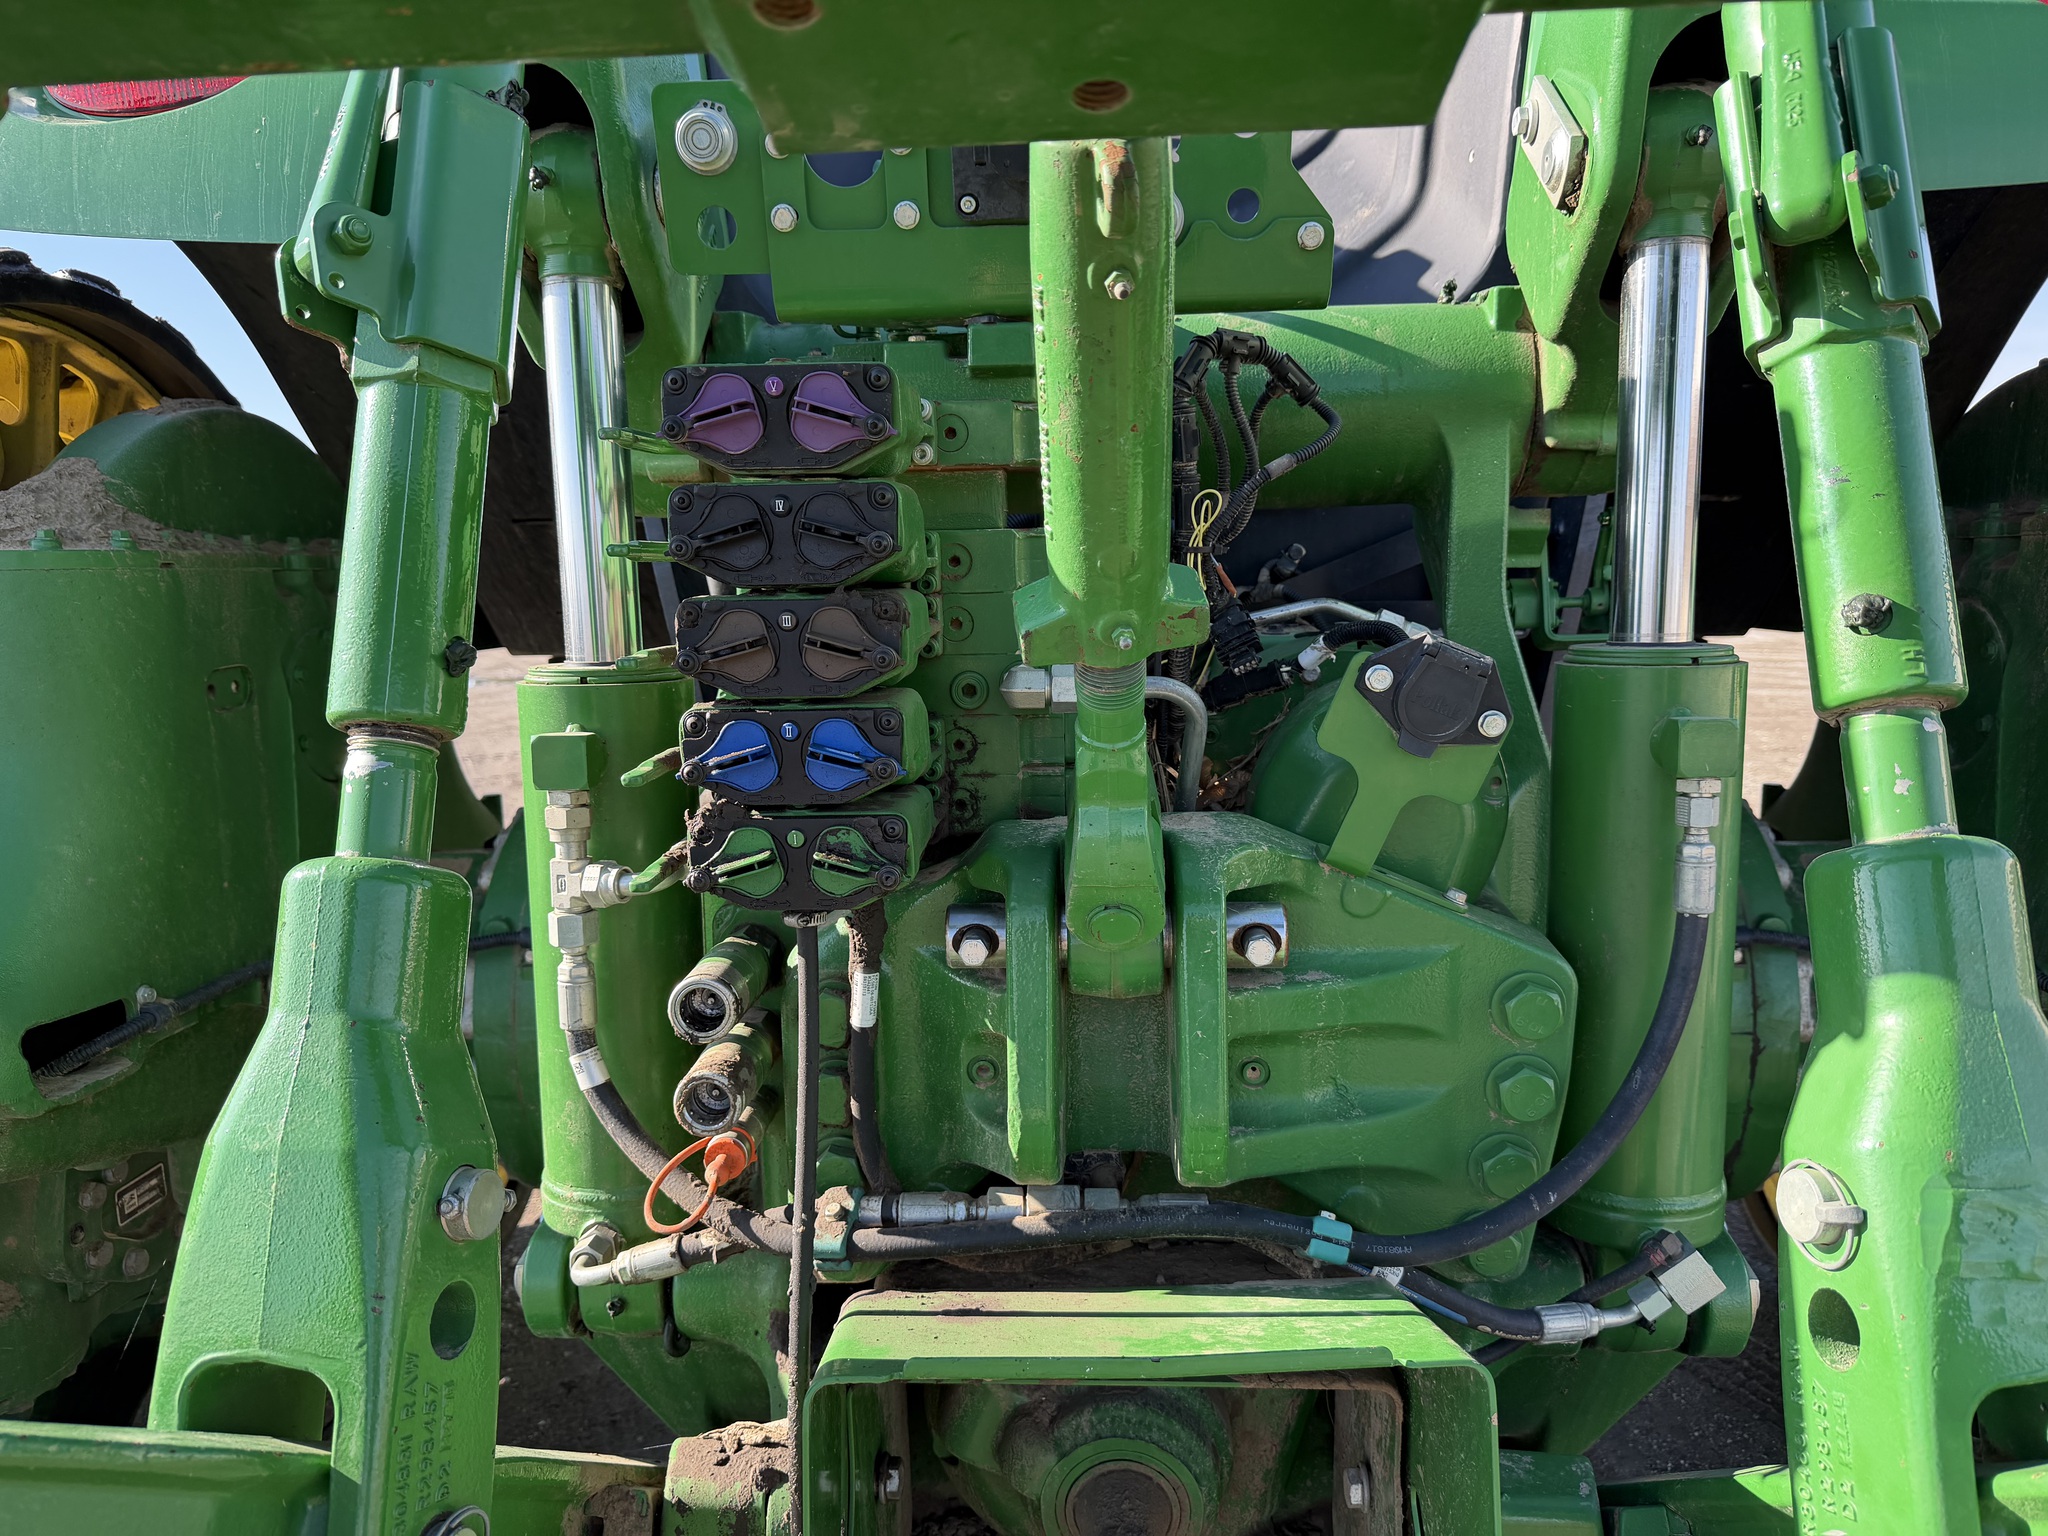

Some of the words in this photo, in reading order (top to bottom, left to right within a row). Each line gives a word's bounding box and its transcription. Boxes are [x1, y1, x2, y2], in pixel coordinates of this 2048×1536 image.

[769, 380, 778, 392] V
[775, 500, 785, 512] IV
[782, 615, 791, 626] III
[785, 725, 792, 738] II
[399, 1351, 420, 1420] RAW
[415, 1381, 440, 1512] R298457
[1811, 1378, 1838, 1515] R298457
[1839, 1478, 1858, 1523] D2
